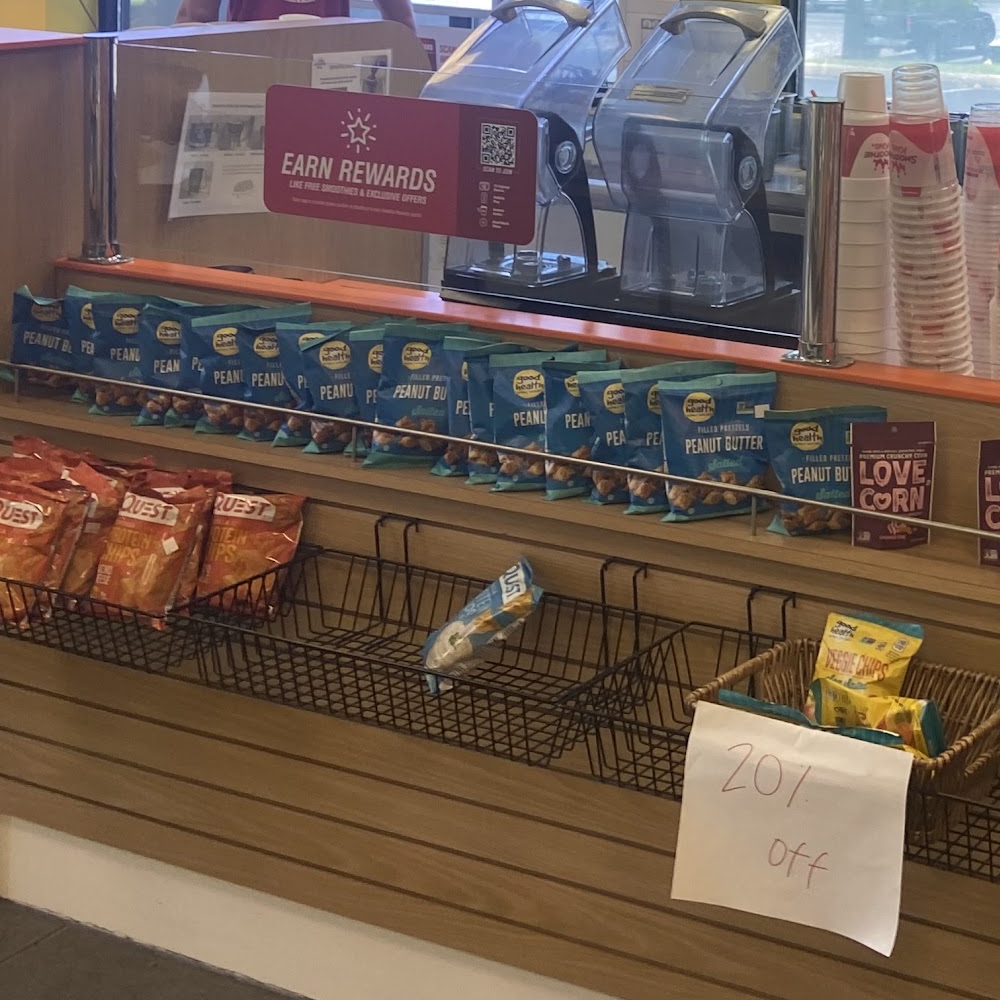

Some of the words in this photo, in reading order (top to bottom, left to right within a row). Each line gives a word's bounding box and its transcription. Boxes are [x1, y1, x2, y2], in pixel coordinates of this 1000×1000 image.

[281, 152, 334, 180] EARN
[338, 158, 437, 193] REWARDS
[289, 180, 304, 189] LIKE
[304, 182, 320, 191] FREE
[321, 183, 359, 197] SMOOTHIES
[360, 188, 365, 197] &
[366, 189, 400, 202] EXCLUSIVE
[401, 193, 427, 205] OFFERS
[23, 331, 61, 350] PEANUT
[323, 344, 347, 355] good
[322, 351, 351, 362] health
[515, 381, 545, 391] health
[516, 374, 541, 385] good
[393, 384, 432, 399] PEANUT
[685, 404, 714, 414] health
[686, 397, 712, 409] good
[697, 425, 718, 434] FILLED
[719, 423, 750, 432] PRETZELS
[794, 425, 819, 437] good
[792, 433, 823, 443] health
[685, 437, 723, 455] PEANUT
[725, 435, 764, 451] BUTTER
[805, 454, 827, 462] FILLED
[791, 466, 831, 484] PEANUT
[859, 459, 927, 487] LOVE
[859, 486, 925, 513] CORN
[122, 493, 172, 521] QUEST
[825, 648, 856, 674] VEGGIE
[856, 654, 889, 681] CHIPS
